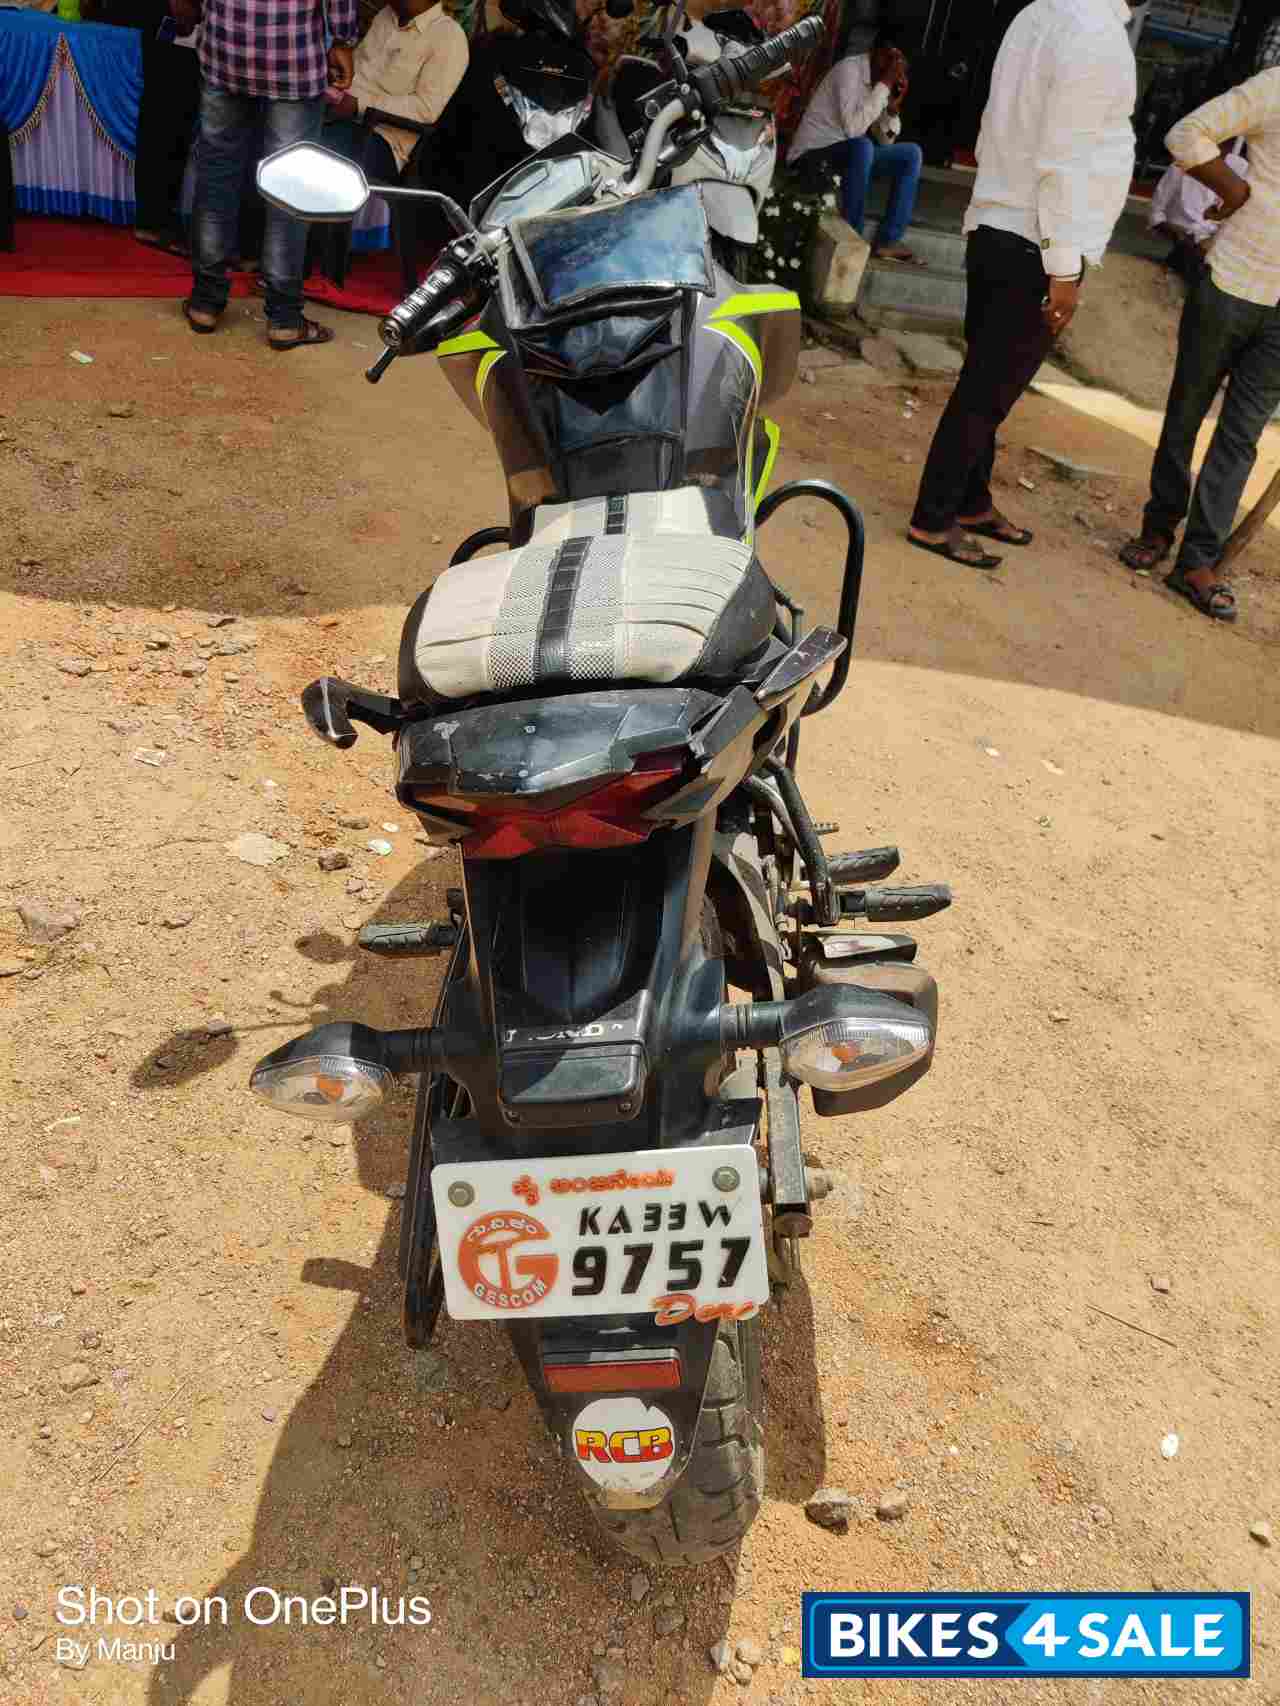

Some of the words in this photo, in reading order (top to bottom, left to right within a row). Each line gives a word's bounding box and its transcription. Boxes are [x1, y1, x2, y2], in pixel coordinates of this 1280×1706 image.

[571, 1237, 751, 1297] 9757
[472, 1276, 548, 1307] GESCOM
[575, 1427, 674, 1463] RCB
